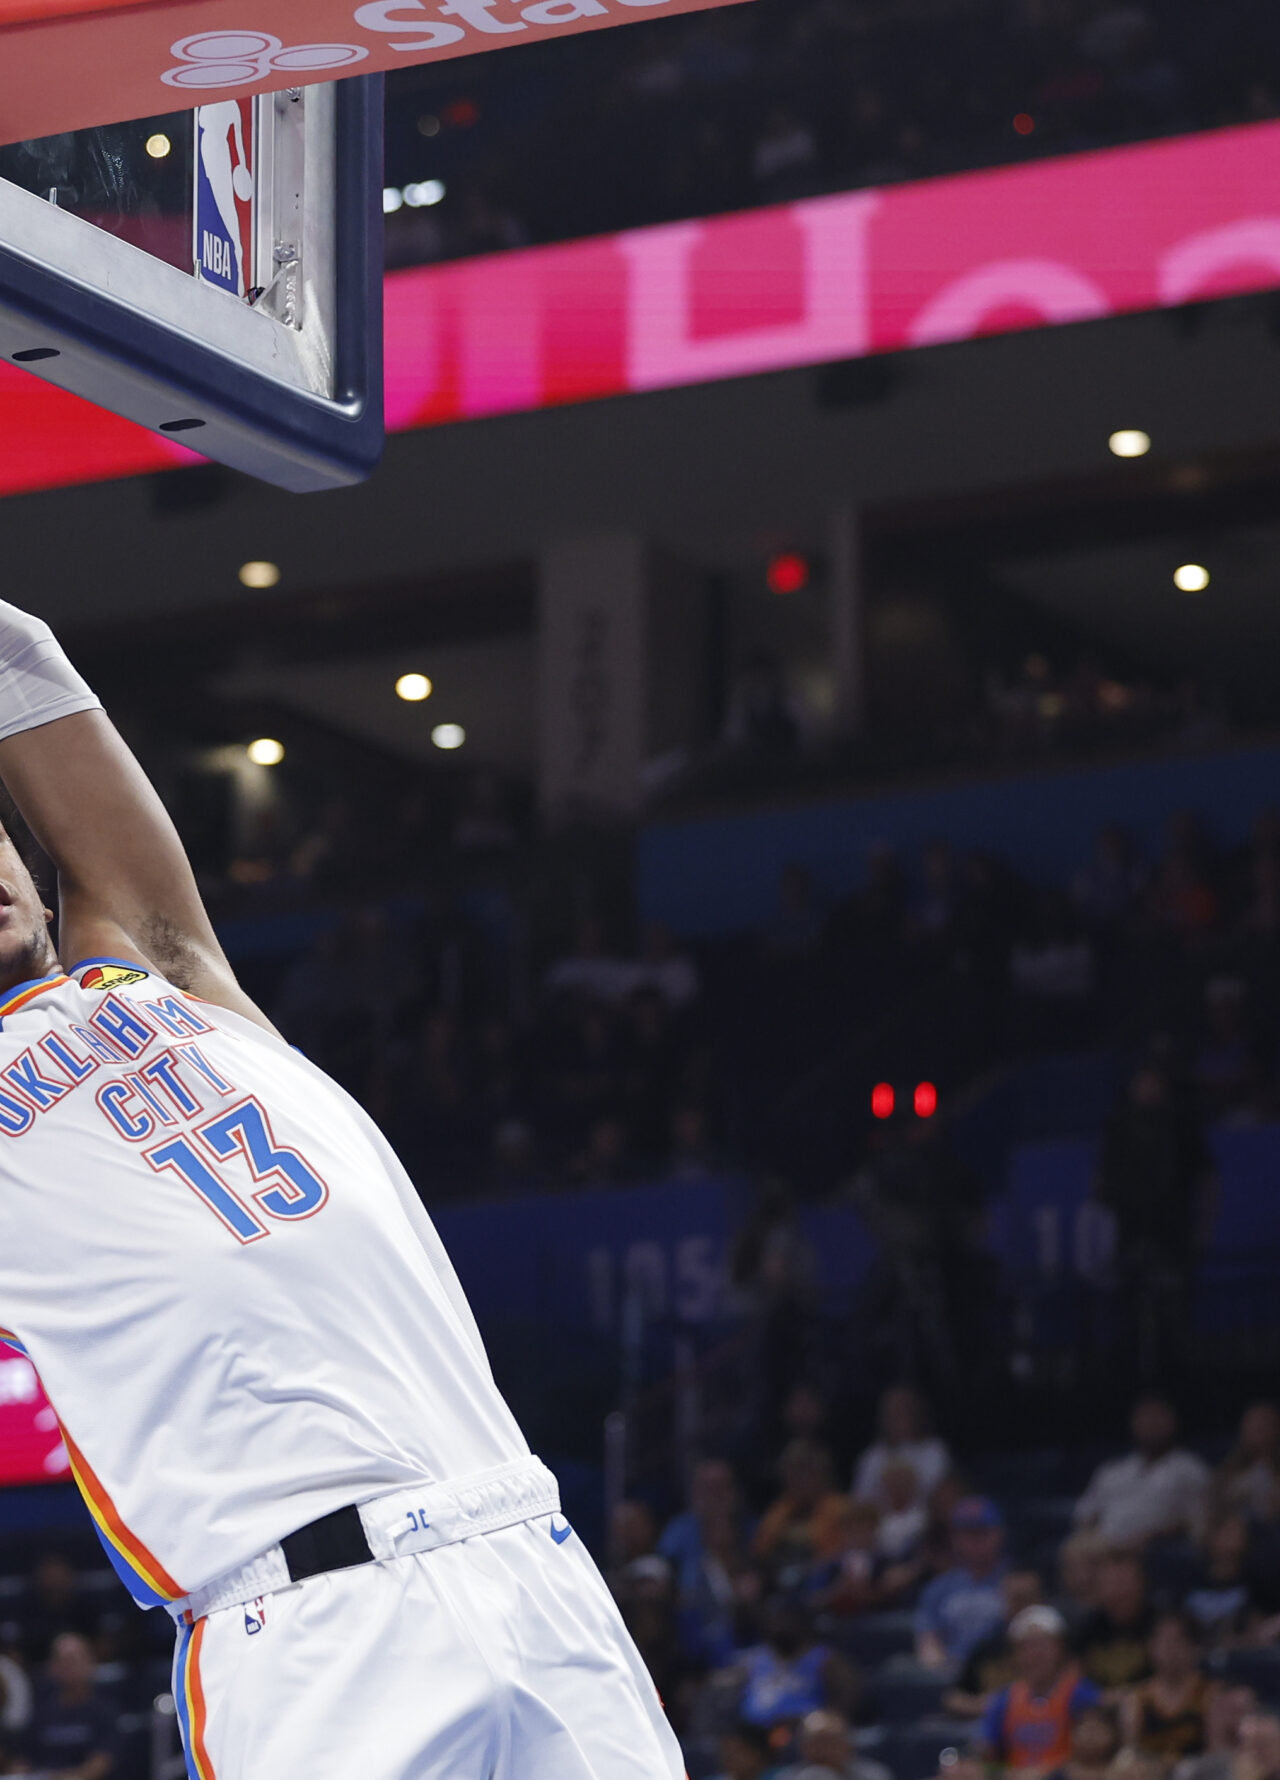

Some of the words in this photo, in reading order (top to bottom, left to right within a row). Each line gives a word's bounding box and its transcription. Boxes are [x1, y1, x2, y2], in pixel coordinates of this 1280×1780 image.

[354, 0, 671, 51] Sta
[203, 230, 231, 280] NBA
[95, 1043, 235, 1142] CITY
[141, 1094, 329, 1245] 13
